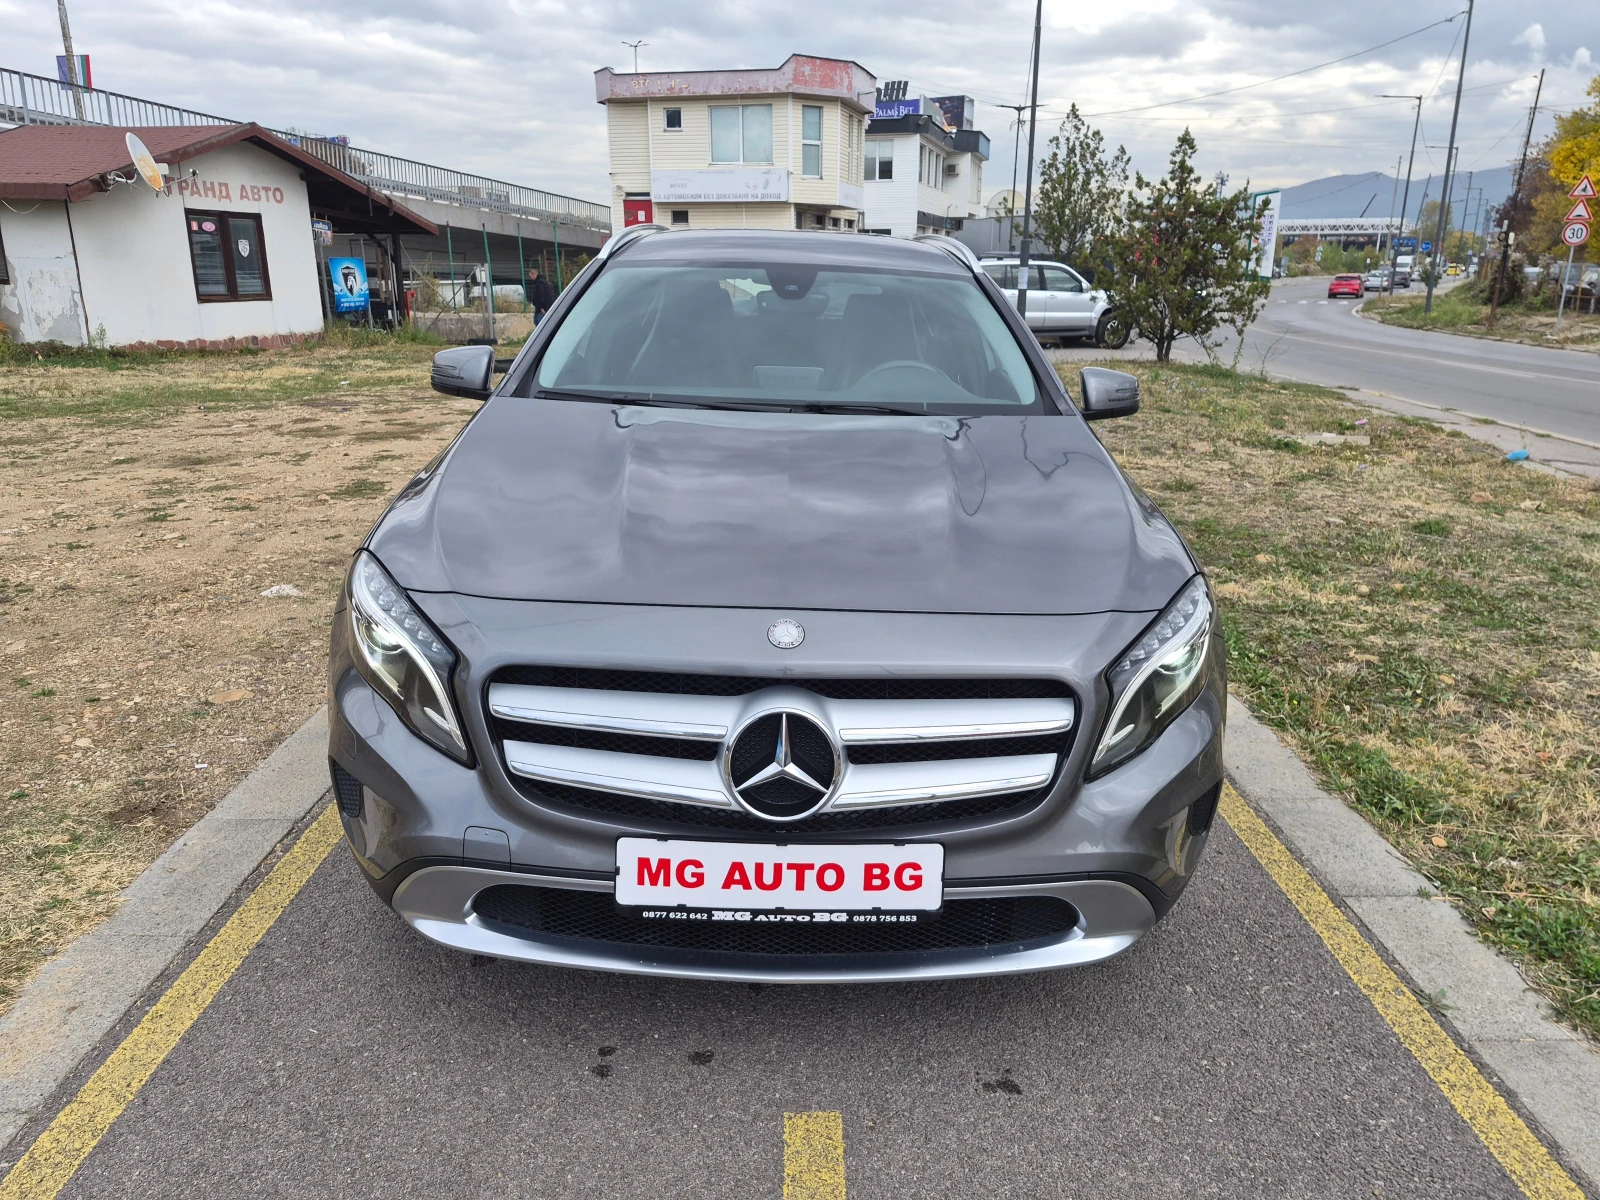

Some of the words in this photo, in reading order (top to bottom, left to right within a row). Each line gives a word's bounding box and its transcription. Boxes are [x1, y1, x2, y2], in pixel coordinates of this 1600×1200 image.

[166, 176, 232, 203] ГРАНД
[239, 184, 285, 204] АВТО
[703, 192, 714, 200] БЕЗ
[715, 192, 750, 200] ДОКАЗВАНЕ
[760, 192, 781, 200] ДОХОД
[1567, 227, 1584, 240] 30
[637, 857, 705, 888] MG
[721, 861, 846, 892] AUTO
[862, 861, 924, 892] BG
[642, 911, 668, 919] 0877
[668, 912, 688, 920] 622
[689, 912, 708, 921] 642
[711, 911, 753, 922] MG
[754, 914, 811, 922] AUTO
[812, 912, 850, 923] BG
